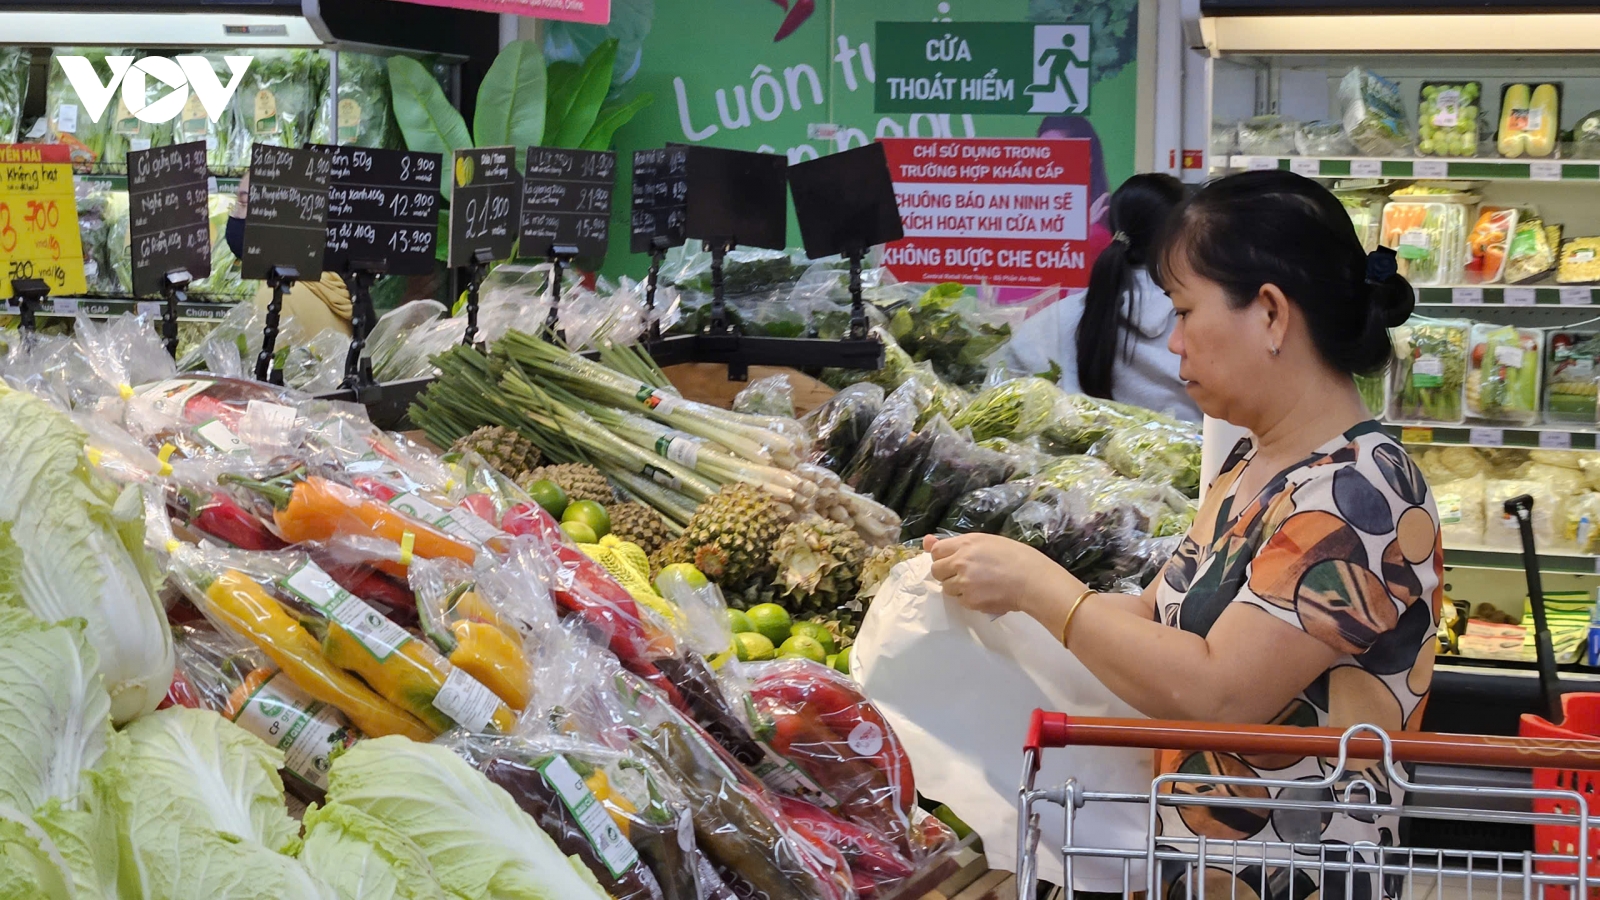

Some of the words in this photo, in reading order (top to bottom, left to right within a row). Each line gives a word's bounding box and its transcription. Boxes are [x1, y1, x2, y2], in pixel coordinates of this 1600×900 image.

[926, 33, 972, 61] CỬA
[886, 71, 957, 100] THOÁT
[960, 68, 1015, 101] HIỂM
[673, 64, 824, 142] Luôn
[913, 142, 937, 159] CHỈ
[939, 143, 960, 158] SỬ
[962, 145, 1002, 162] DỤNG
[1004, 146, 1051, 159] TRONG
[42, 165, 58, 182] hạt
[352, 151, 372, 172] 50g
[400, 155, 435, 181] 8.900
[900, 163, 957, 178] TRƯỜNG
[960, 164, 990, 181] HỢP
[992, 162, 1033, 178] KHẨN
[1035, 161, 1065, 179] CẤP
[389, 193, 434, 217] 12.900
[955, 190, 985, 209] BÁO
[988, 195, 1010, 209] AN
[1014, 195, 1049, 210] NINH
[1053, 191, 1073, 211] SẼ
[900, 211, 933, 230] KÍCH
[937, 215, 975, 235] HOẠT
[978, 216, 1003, 231] KHI
[1006, 213, 1036, 232] CỬA
[1040, 213, 1065, 233] MỞ
[354, 224, 376, 245] 100g
[388, 229, 432, 253] 13.900
[881, 243, 941, 266] KHÔNG
[945, 247, 994, 271] ĐƯỢC
[997, 250, 1033, 268] CHE
[1035, 242, 1085, 269] CHẮN
[90, 305, 110, 315] GAP
[268, 720, 281, 735] CP
